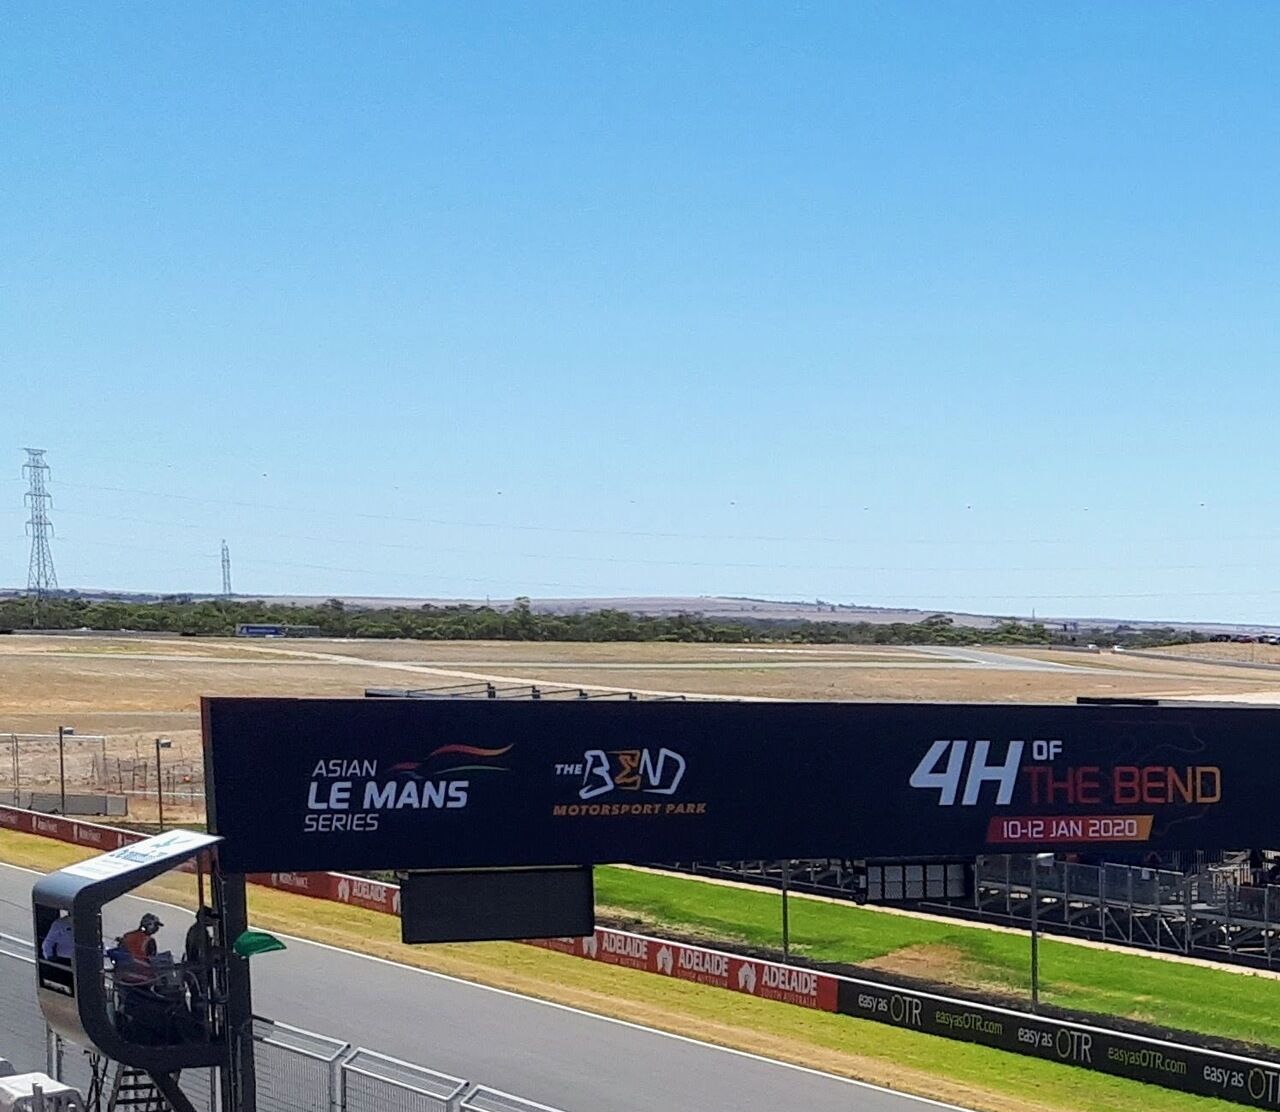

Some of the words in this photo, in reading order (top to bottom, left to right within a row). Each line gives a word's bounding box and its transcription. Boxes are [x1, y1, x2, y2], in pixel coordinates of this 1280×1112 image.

[312, 760, 377, 776] ASIAN
[555, 763, 582, 775] THE
[579, 748, 686, 799] BEND
[909, 740, 1024, 805] 4H
[1033, 740, 1062, 760] OF
[307, 781, 353, 809] LE
[363, 780, 468, 808] MANS
[1022, 766, 1101, 804] THE
[1113, 766, 1222, 803] BEND
[304, 814, 378, 831] SERIES
[553, 803, 661, 816] MOTORSPORT
[665, 802, 706, 814] PARK
[1003, 820, 1044, 838] 10-12
[1050, 819, 1082, 837] JAN
[1088, 819, 1137, 836] 2020
[352, 881, 387, 903] ADELAIDE
[602, 932, 647, 959] ADELAIDE
[678, 949, 728, 977] ADELAIDE
[761, 966, 817, 996] ADELAIDE
[858, 993, 877, 1011] easy
[877, 998, 888, 1012] as
[890, 994, 922, 1026] OTR
[935, 1009, 1003, 1036] easyasOTR.com
[1017, 1025, 1041, 1048] easy
[1040, 1030, 1052, 1047] as
[1056, 1028, 1092, 1063] OTR
[1107, 1046, 1186, 1075] easyasOTR.com
[1203, 1064, 1229, 1089] easy
[1231, 1071, 1245, 1088] as
